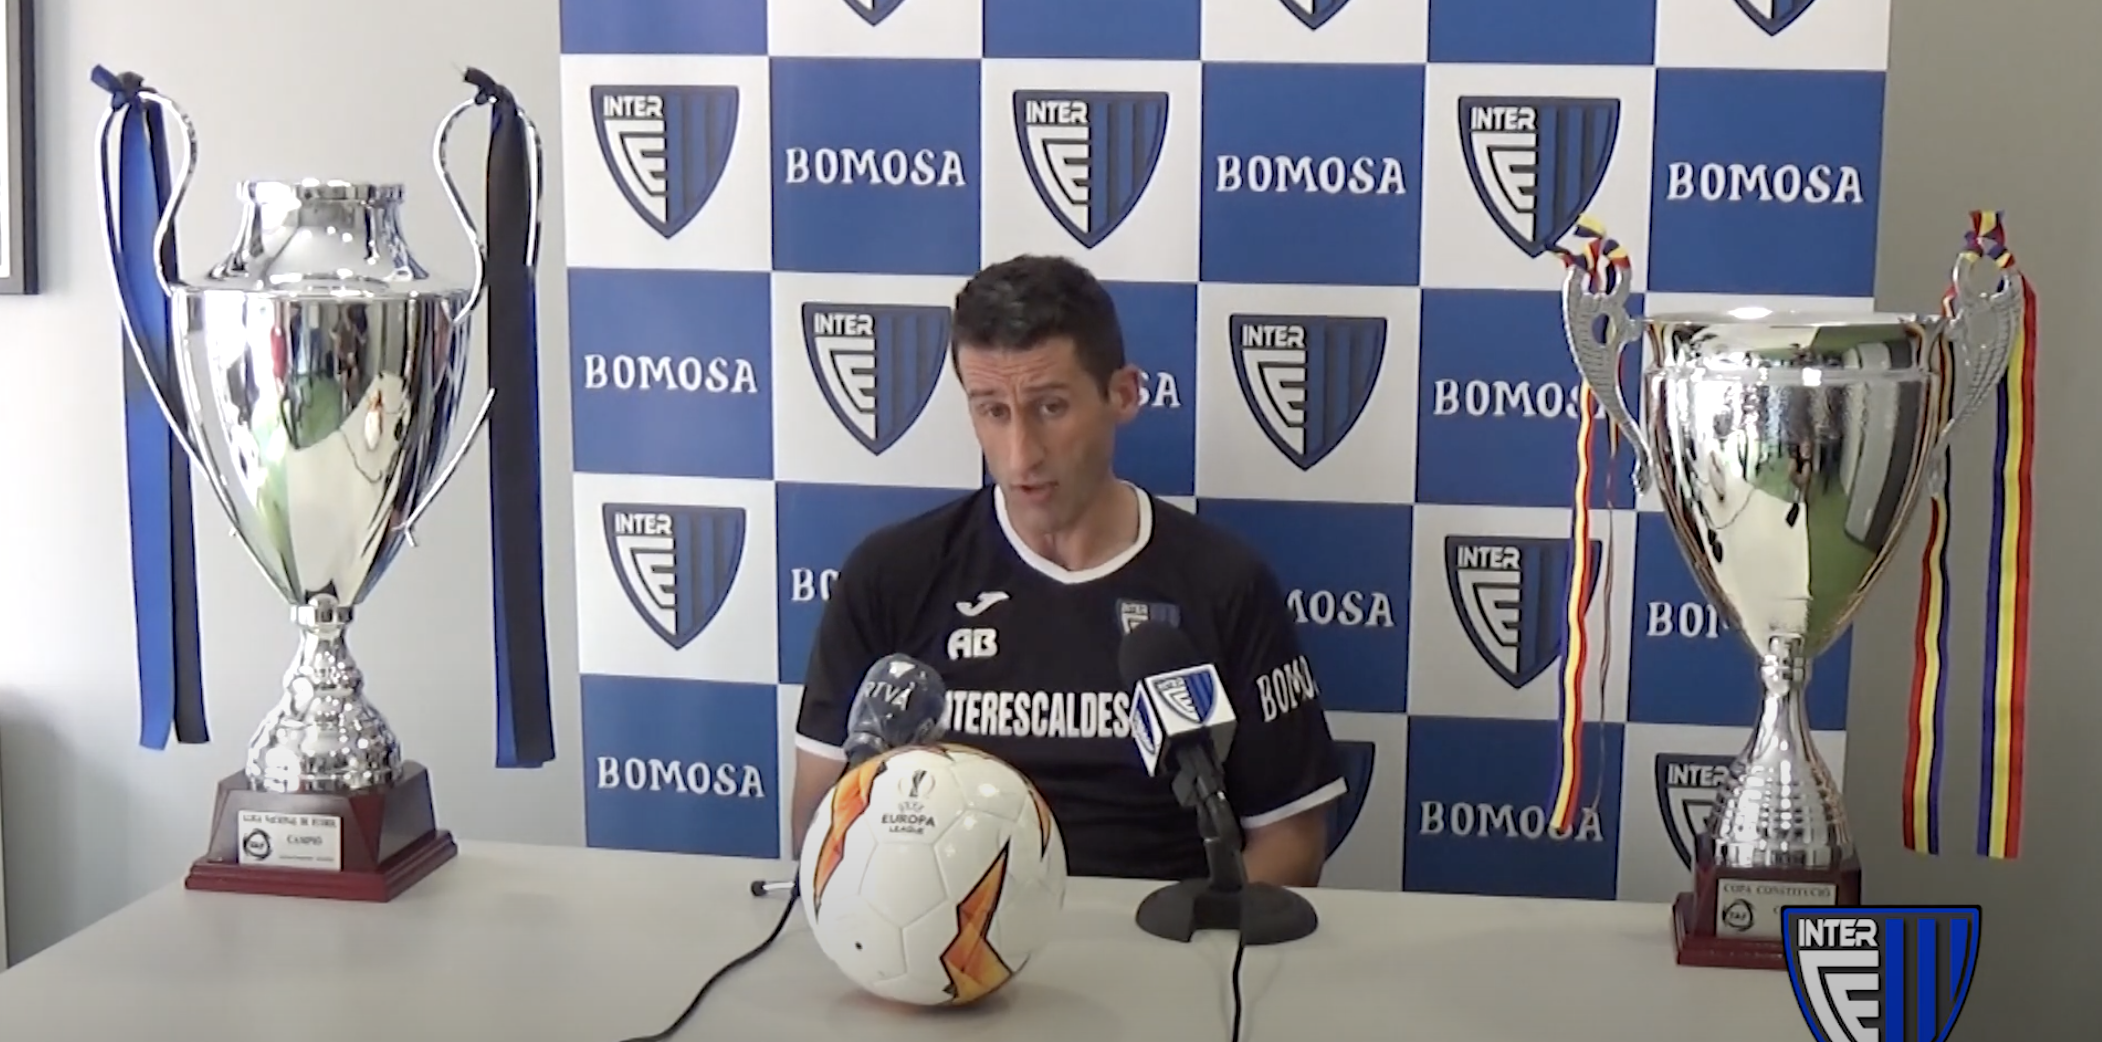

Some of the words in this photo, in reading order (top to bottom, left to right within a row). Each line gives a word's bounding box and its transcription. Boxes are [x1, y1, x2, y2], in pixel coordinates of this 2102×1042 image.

[602, 95, 665, 119] INTER
[1024, 100, 1090, 125] INTER
[1470, 105, 1539, 131] INTER
[785, 147, 968, 188] BOMOSA
[1215, 155, 1407, 195] BOMOSA
[1666, 162, 1865, 204] BOMOSA
[813, 312, 875, 336] INTER
[1241, 323, 1306, 348] INTER
[583, 353, 759, 396] BOMOSA
[1433, 378, 1606, 419] BOMO
[614, 512, 673, 536] INTER
[1456, 545, 1522, 570] INTER
[947, 627, 999, 660] AB
[944, 690, 1132, 738] TERESCALDES
[596, 756, 766, 799] BOMOSA
[881, 813, 936, 828] EUROPA
